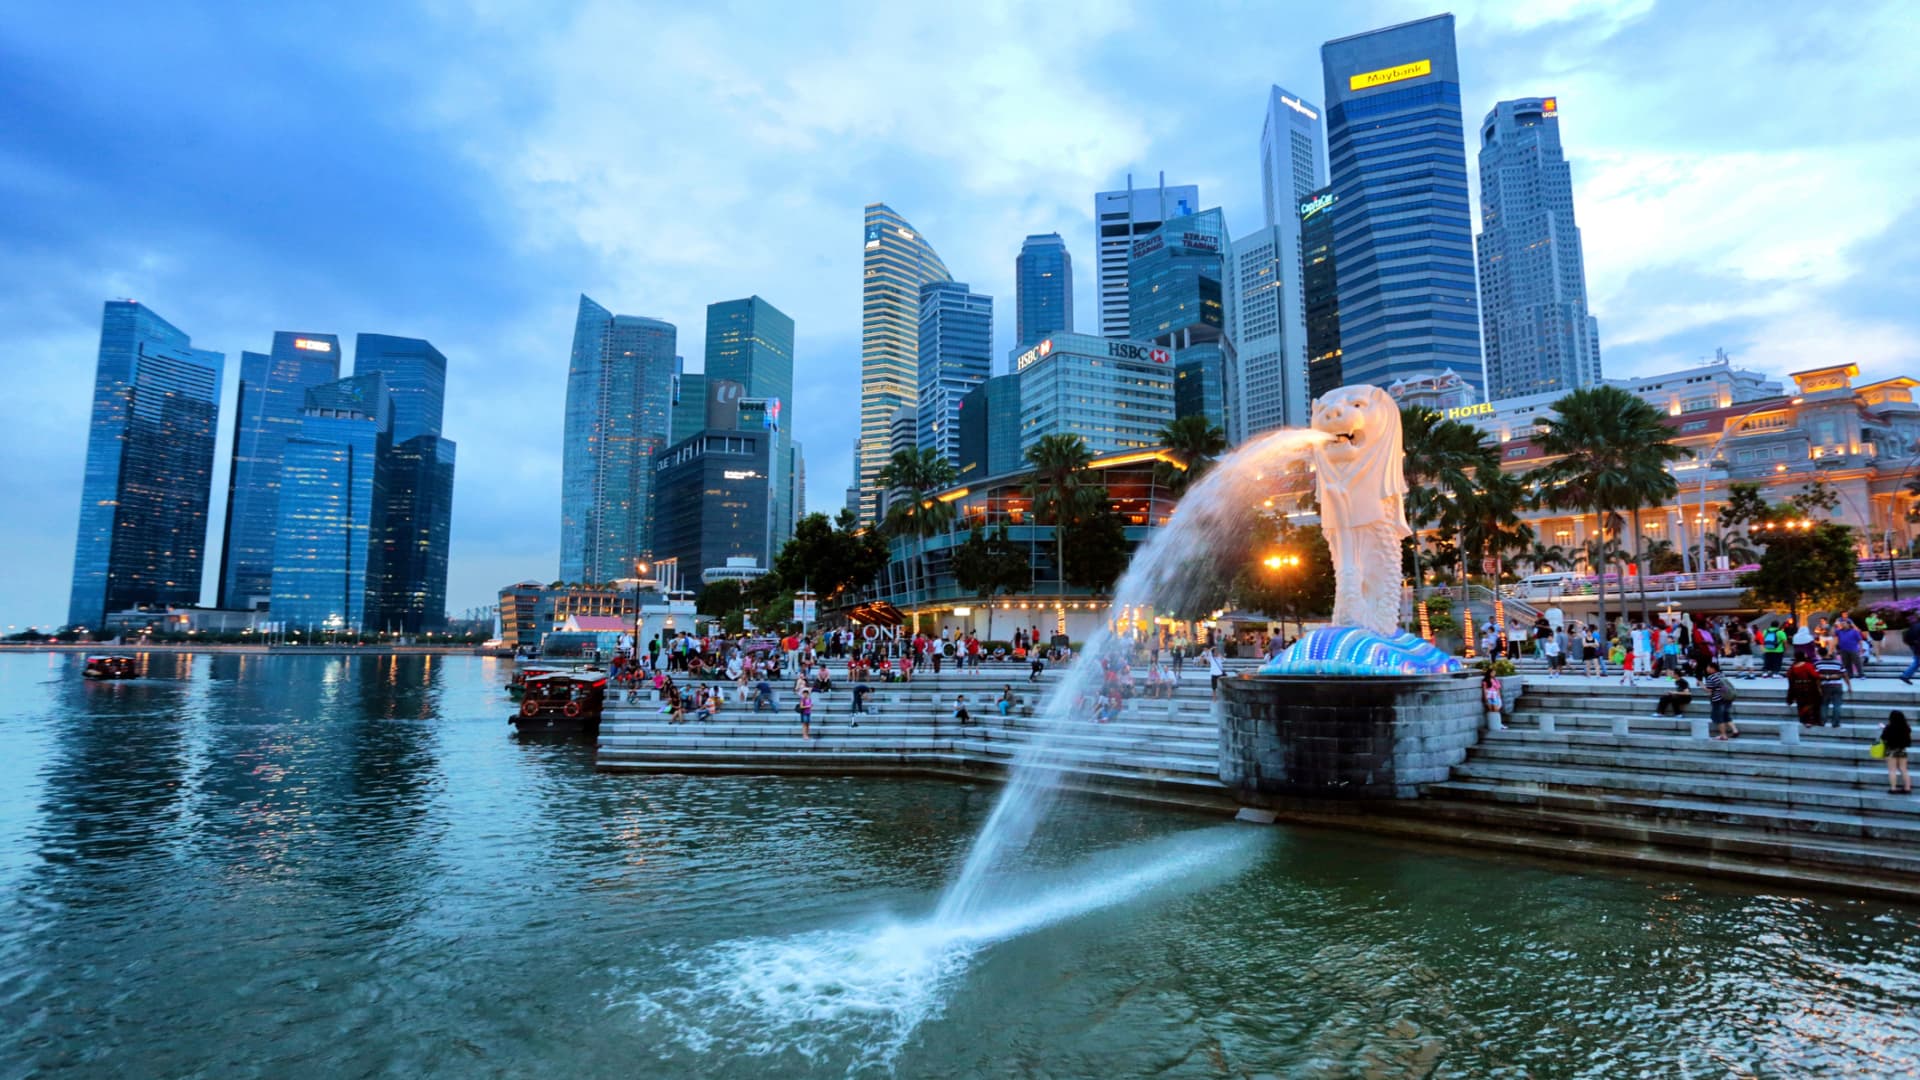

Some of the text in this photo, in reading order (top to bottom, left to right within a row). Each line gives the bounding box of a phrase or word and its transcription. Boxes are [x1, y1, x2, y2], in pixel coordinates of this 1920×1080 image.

[1367, 65, 1422, 83] Maybank
[1018, 347, 1039, 370] HSBC
[1108, 341, 1148, 361] HSBC
[1449, 402, 1494, 419] HOTEL
[863, 624, 905, 641] ONE
